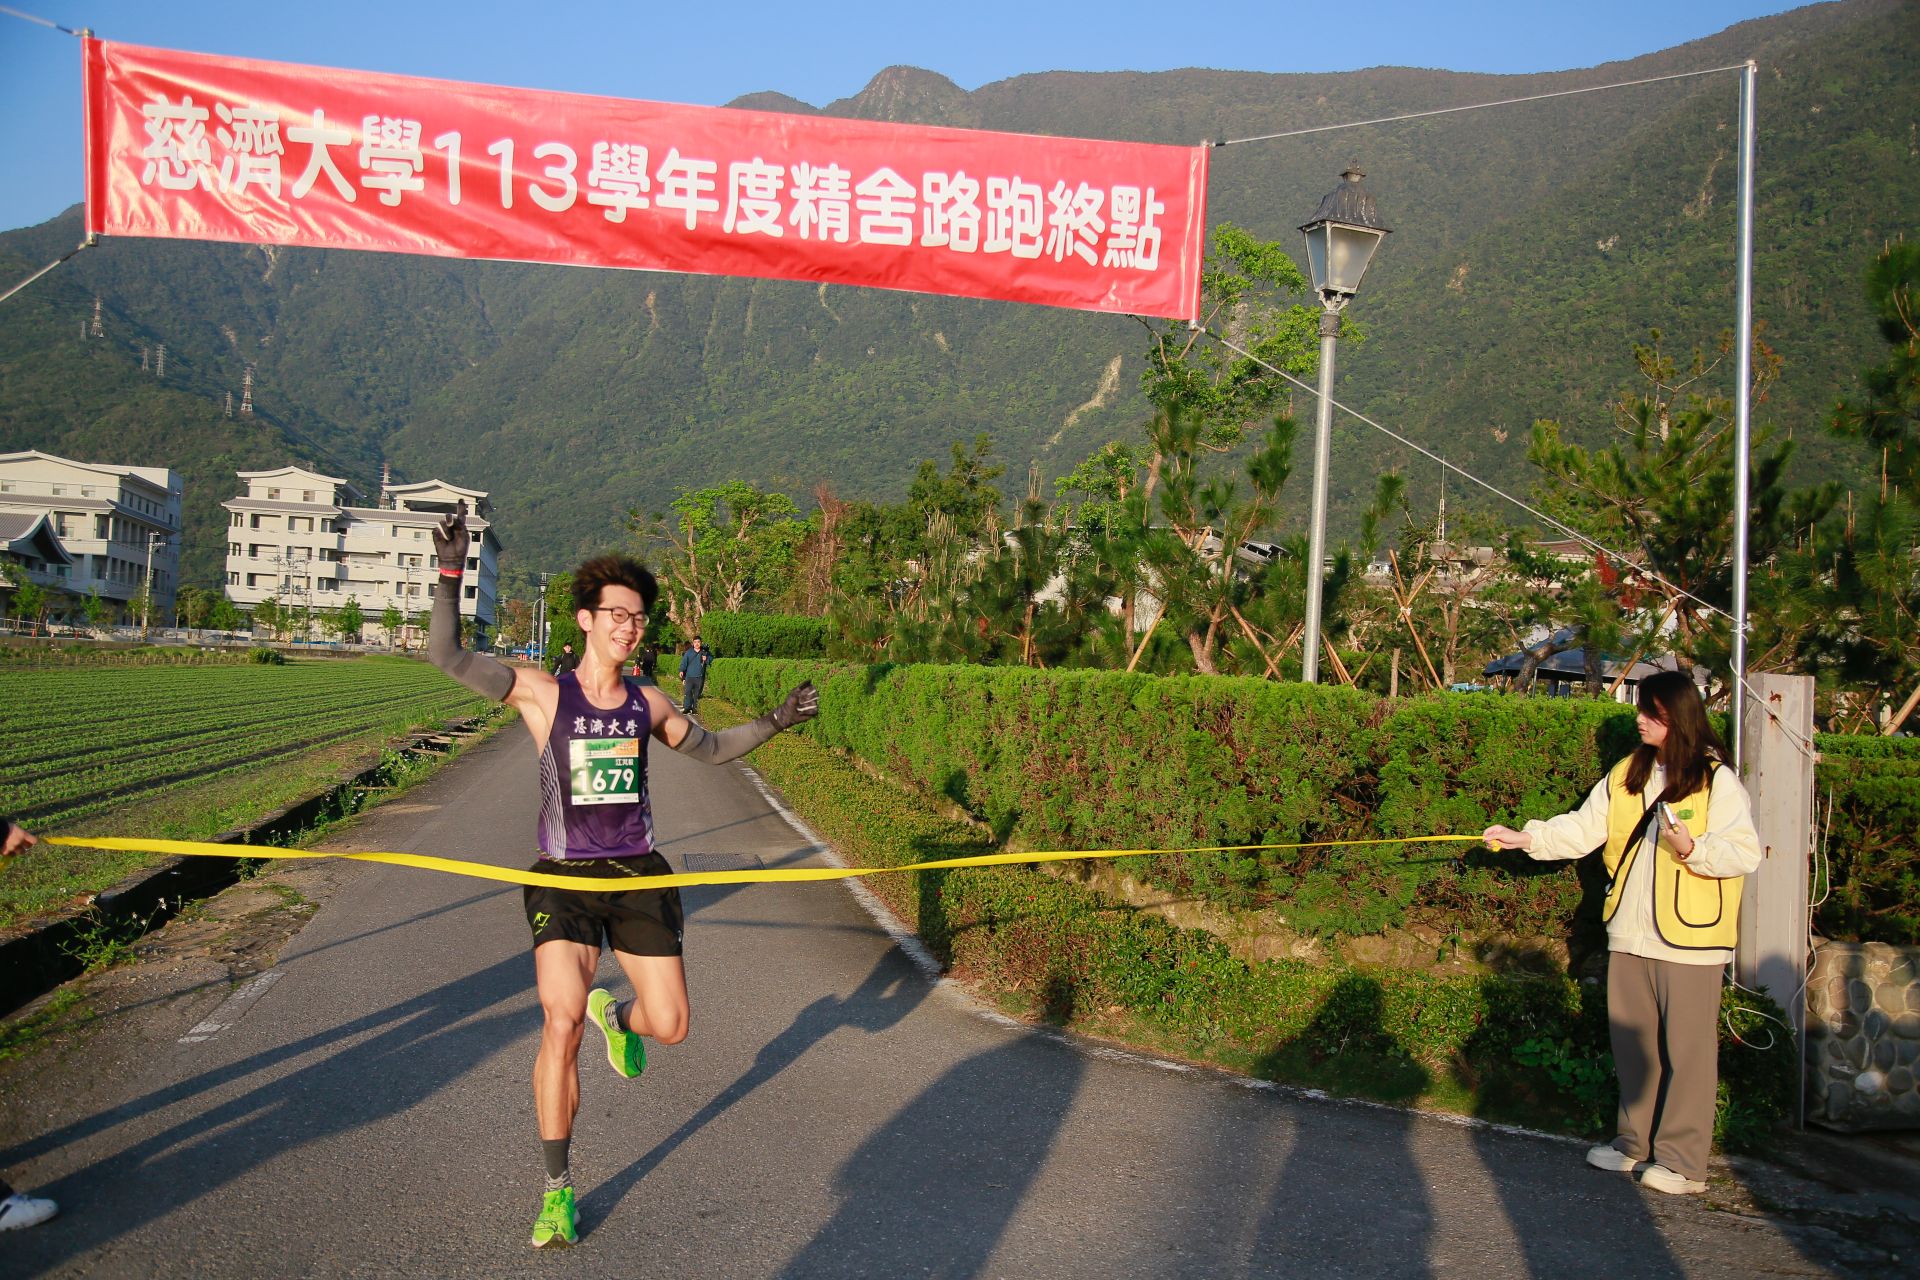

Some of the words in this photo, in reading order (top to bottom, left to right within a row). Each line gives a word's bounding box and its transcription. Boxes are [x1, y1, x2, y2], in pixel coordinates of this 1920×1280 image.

[141, 93, 1166, 272] 慈濟大學113學年度精舍路跑終點
[573, 715, 638, 737] 慈濟大學
[577, 768, 635, 792] 1679
